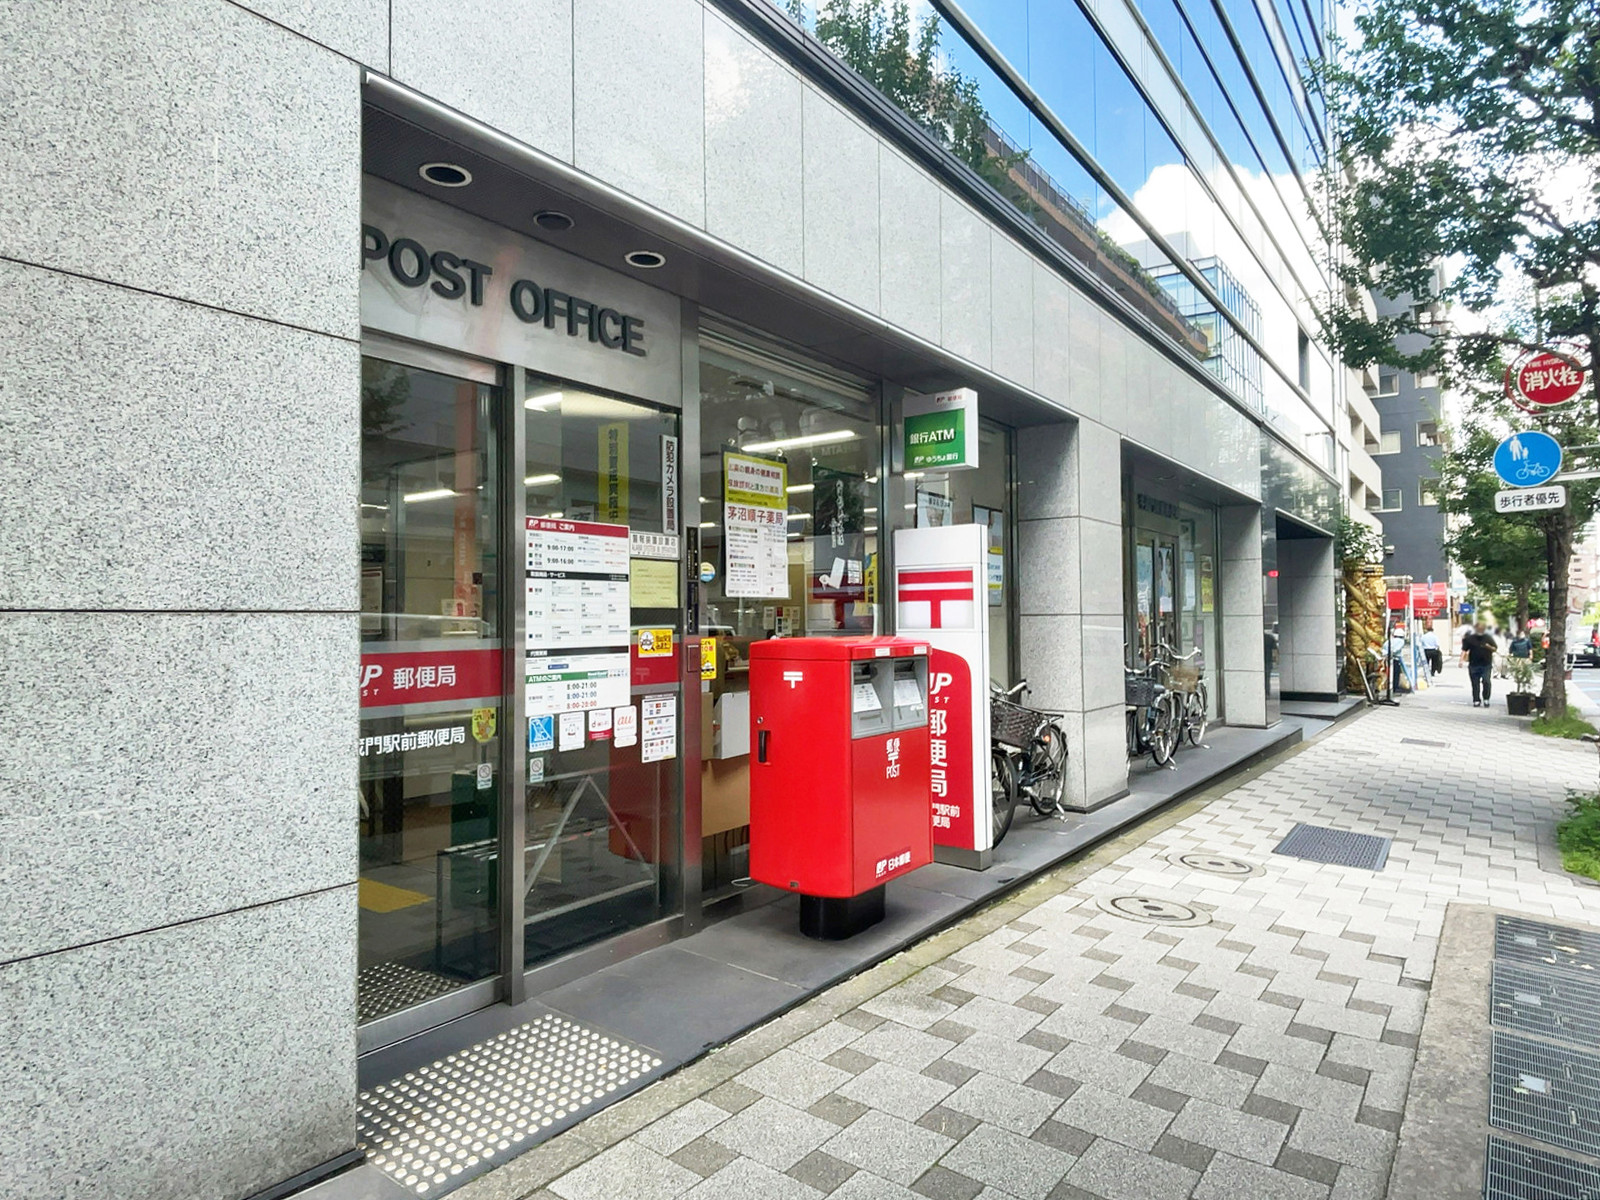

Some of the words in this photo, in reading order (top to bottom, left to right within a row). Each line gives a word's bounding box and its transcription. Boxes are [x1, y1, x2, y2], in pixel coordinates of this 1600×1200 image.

[361, 224, 493, 307] POST
[510, 279, 647, 358] OFFICE
[1523, 365, 1581, 393] 消火栓
[909, 428, 955, 445] 銀行ATM
[925, 452, 959, 463] ゆうちょ銀行
[666, 440, 675, 531] 防犯カメラ設置局
[1500, 491, 1560, 509] 歩行者優先
[727, 505, 784, 526] 茅沼順子薬局
[559, 523, 575, 532] ご案内
[546, 544, 574, 552] 9:00-17:00
[546, 557, 574, 565] 9:00-16:00
[393, 665, 456, 690] 郵便局
[528, 674, 562, 683] ATMのご案内
[362, 688, 380, 697] ST
[566, 681, 598, 691] 8:00-21:00
[566, 690, 598, 700] 8:00-21:00
[934, 696, 951, 704] ST
[566, 700, 598, 710] 8:00-20:00
[617, 715, 635, 726] au
[886, 737, 900, 754] 郵便
[886, 764, 901, 779] POST
[931, 803, 961, 818] 門駅前
[888, 850, 911, 871] 日本郵便
